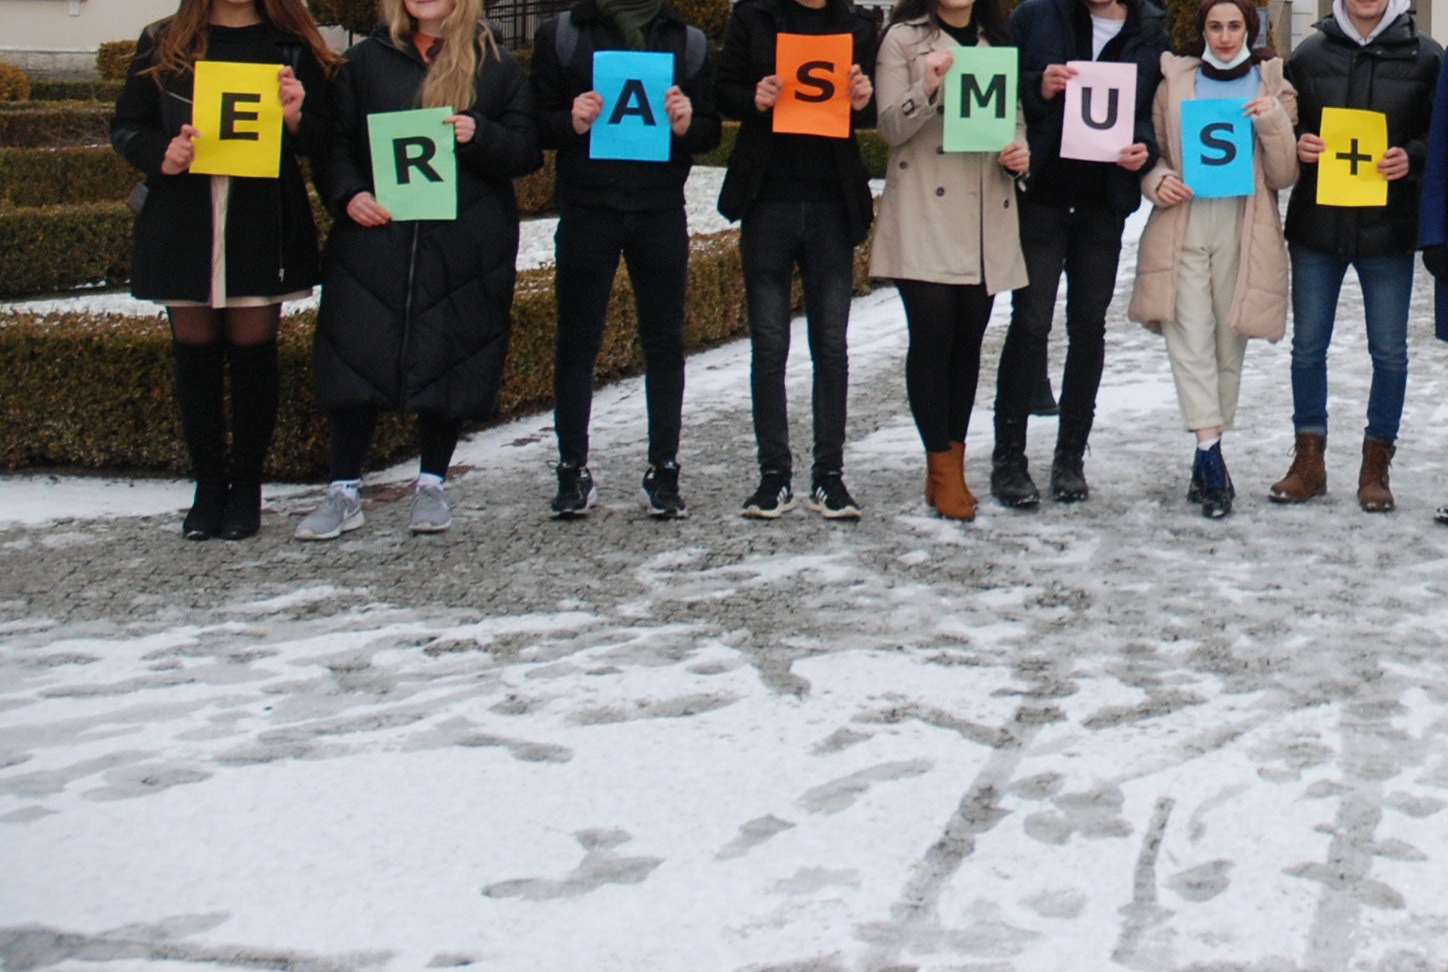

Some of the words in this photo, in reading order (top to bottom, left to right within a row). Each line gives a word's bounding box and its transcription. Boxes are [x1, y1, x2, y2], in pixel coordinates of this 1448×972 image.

[609, 79, 656, 126] A
[795, 60, 835, 103] S
[960, 73, 1006, 119] M
[219, 92, 261, 141] E
[1081, 86, 1119, 131] U
[393, 135, 444, 185] R
[1199, 122, 1237, 166] S
